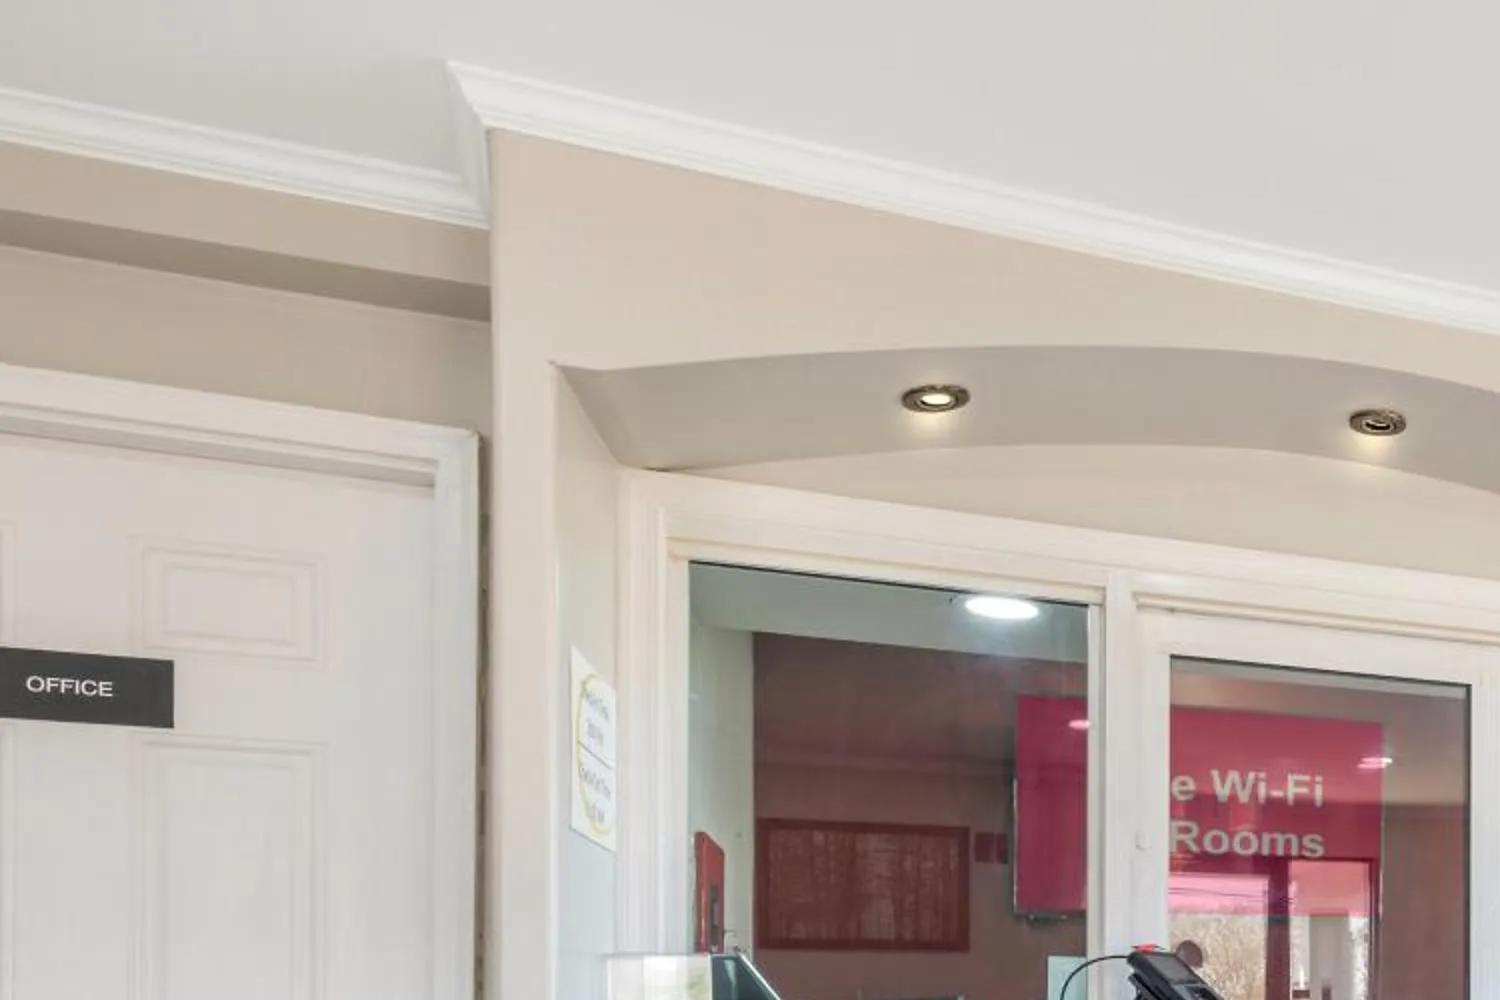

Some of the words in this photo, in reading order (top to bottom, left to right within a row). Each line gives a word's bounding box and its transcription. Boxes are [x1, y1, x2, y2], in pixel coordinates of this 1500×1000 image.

[25, 675, 114, 697] OFFICE
[1210, 769, 1324, 808] Wi-Fi
[1170, 819, 1325, 858] Rooms
